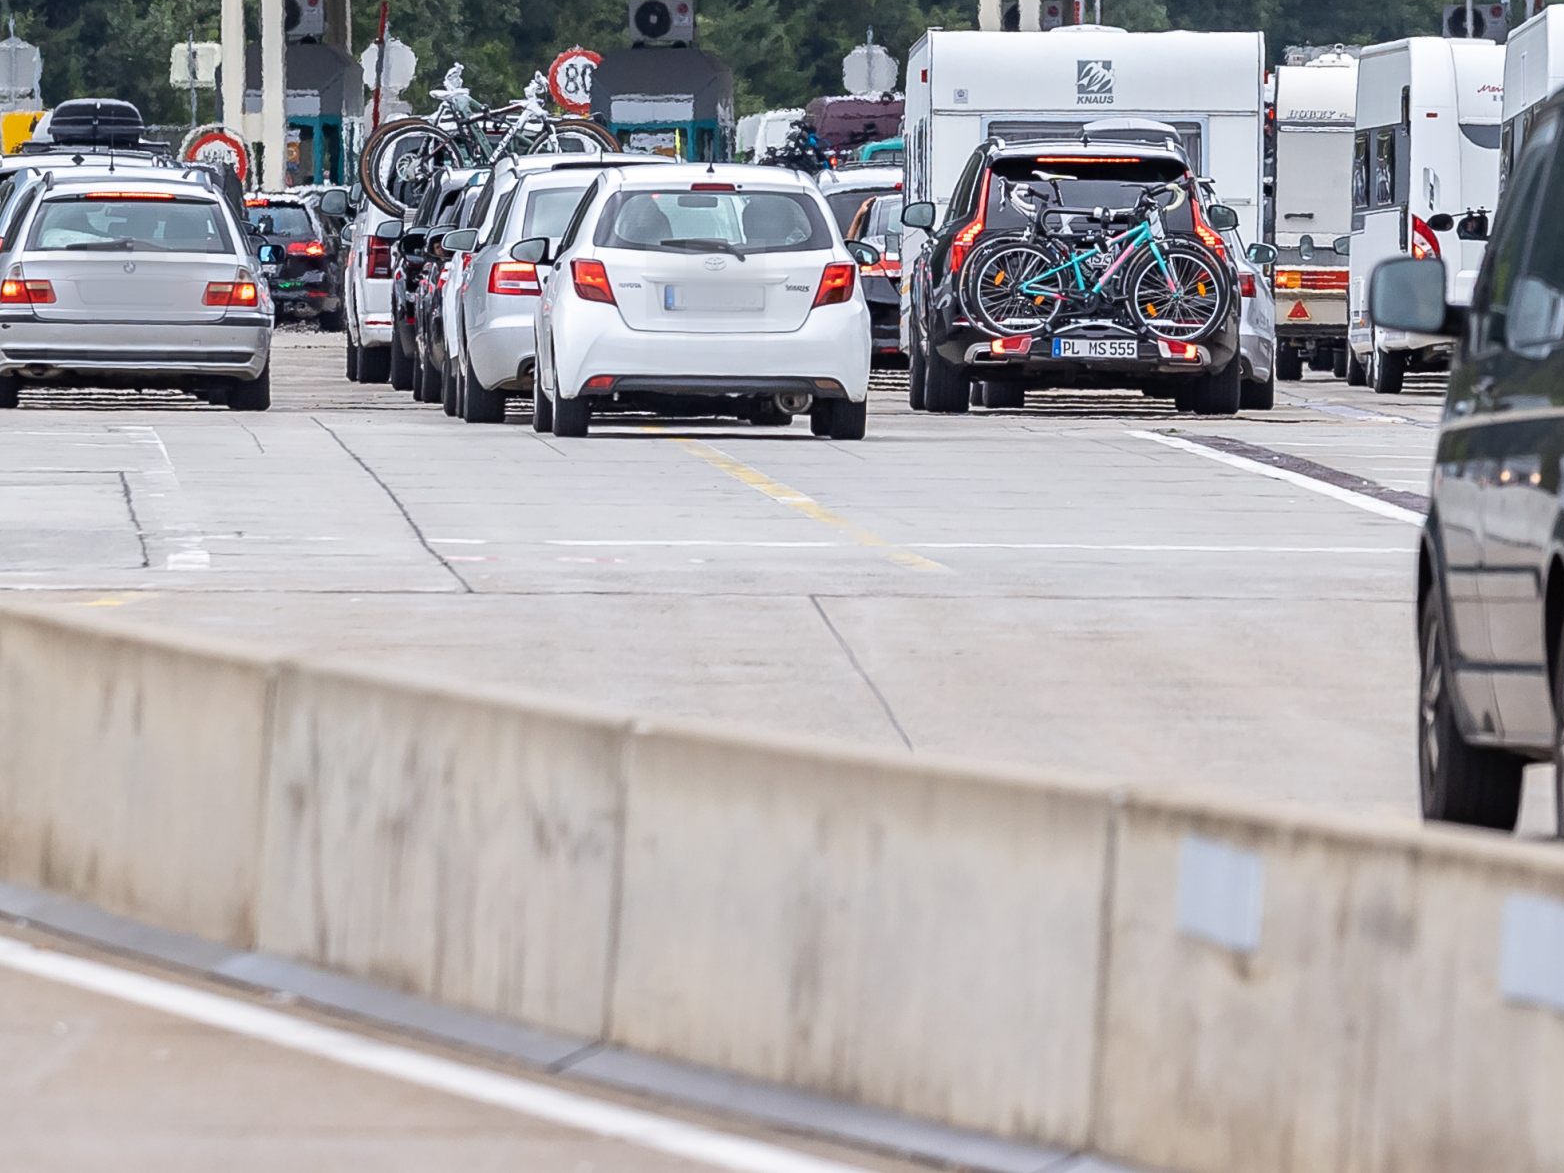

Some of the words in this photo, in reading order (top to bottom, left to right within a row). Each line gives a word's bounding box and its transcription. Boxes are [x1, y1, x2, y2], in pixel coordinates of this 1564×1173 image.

[565, 63, 595, 94] 80
[1076, 95, 1115, 105] KNAUS
[1062, 341, 1080, 355] PL
[1088, 341, 1107, 356] MS
[1109, 341, 1136, 356] 555
